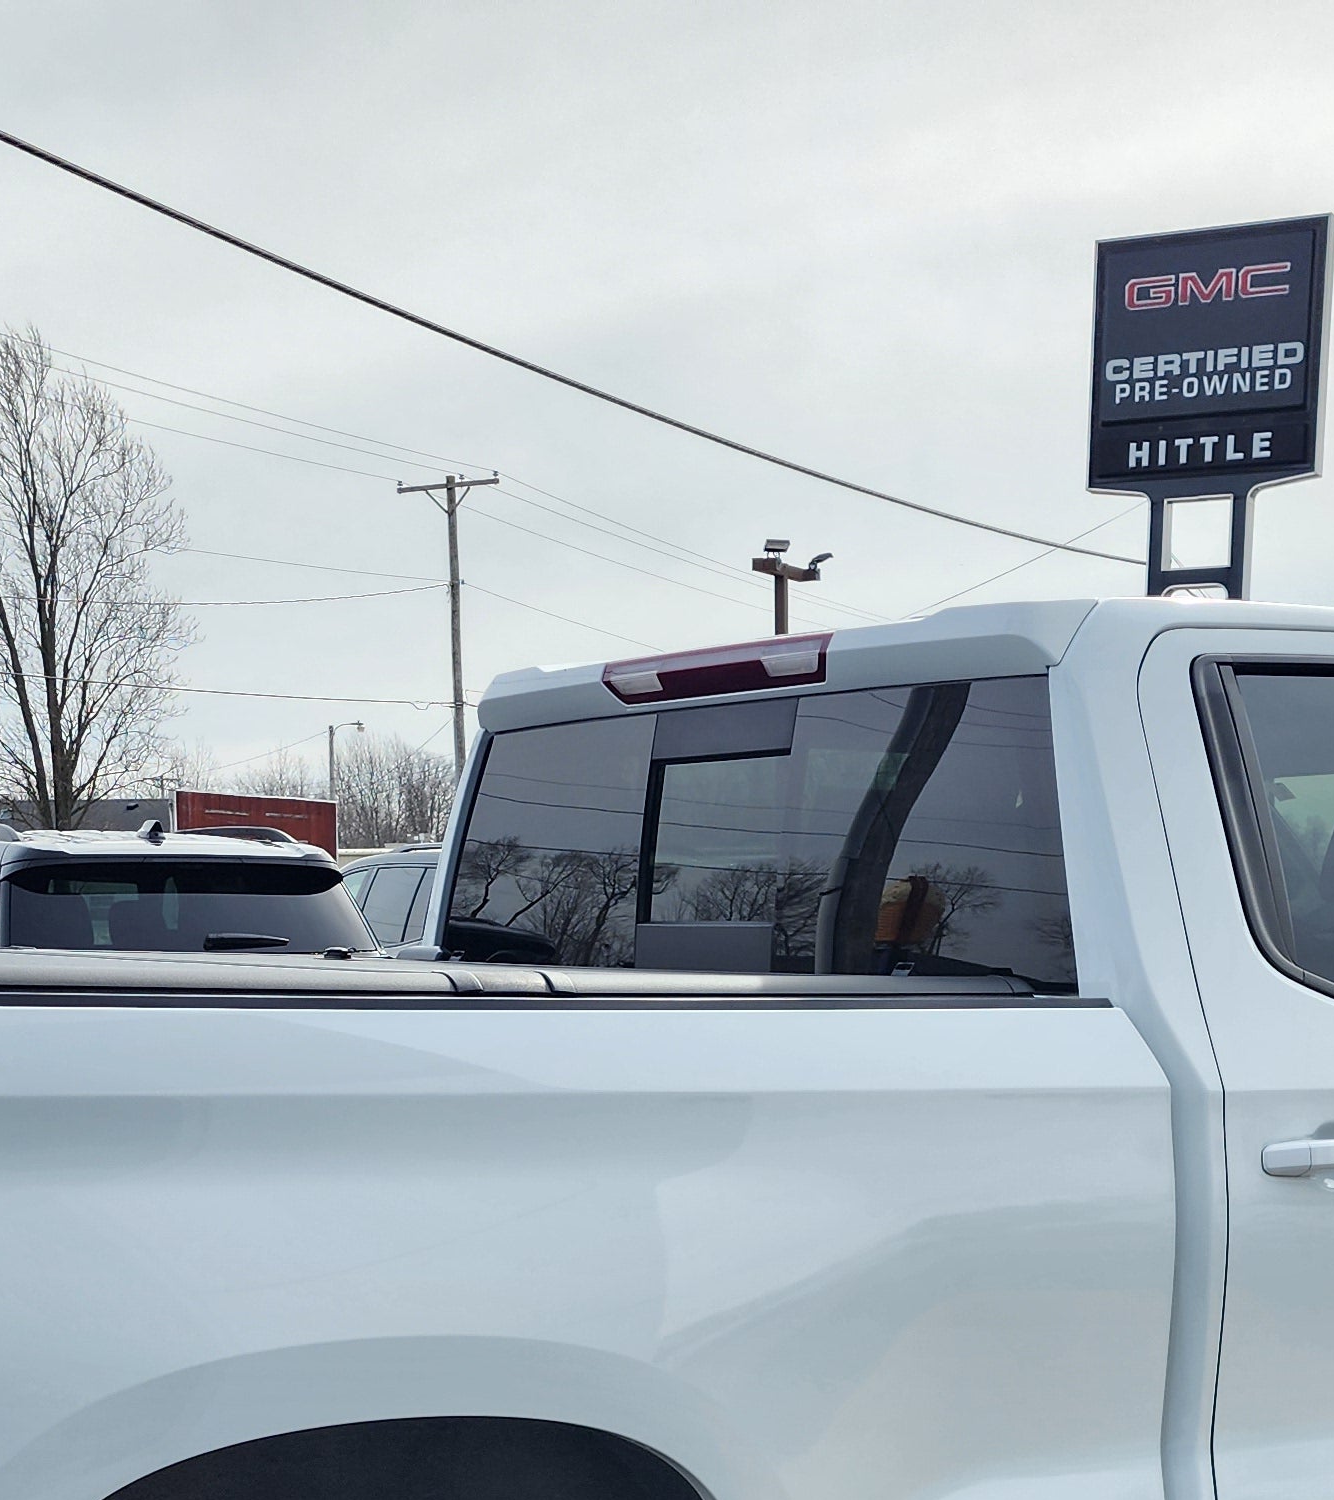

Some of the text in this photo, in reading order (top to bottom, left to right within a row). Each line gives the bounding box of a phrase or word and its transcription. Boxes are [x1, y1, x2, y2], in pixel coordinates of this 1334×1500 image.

[1124, 261, 1292, 311] GMC
[1105, 341, 1305, 382] CERTIFIED
[1115, 368, 1292, 404] PRE-OWNED
[1128, 431, 1273, 469] HITTLE
